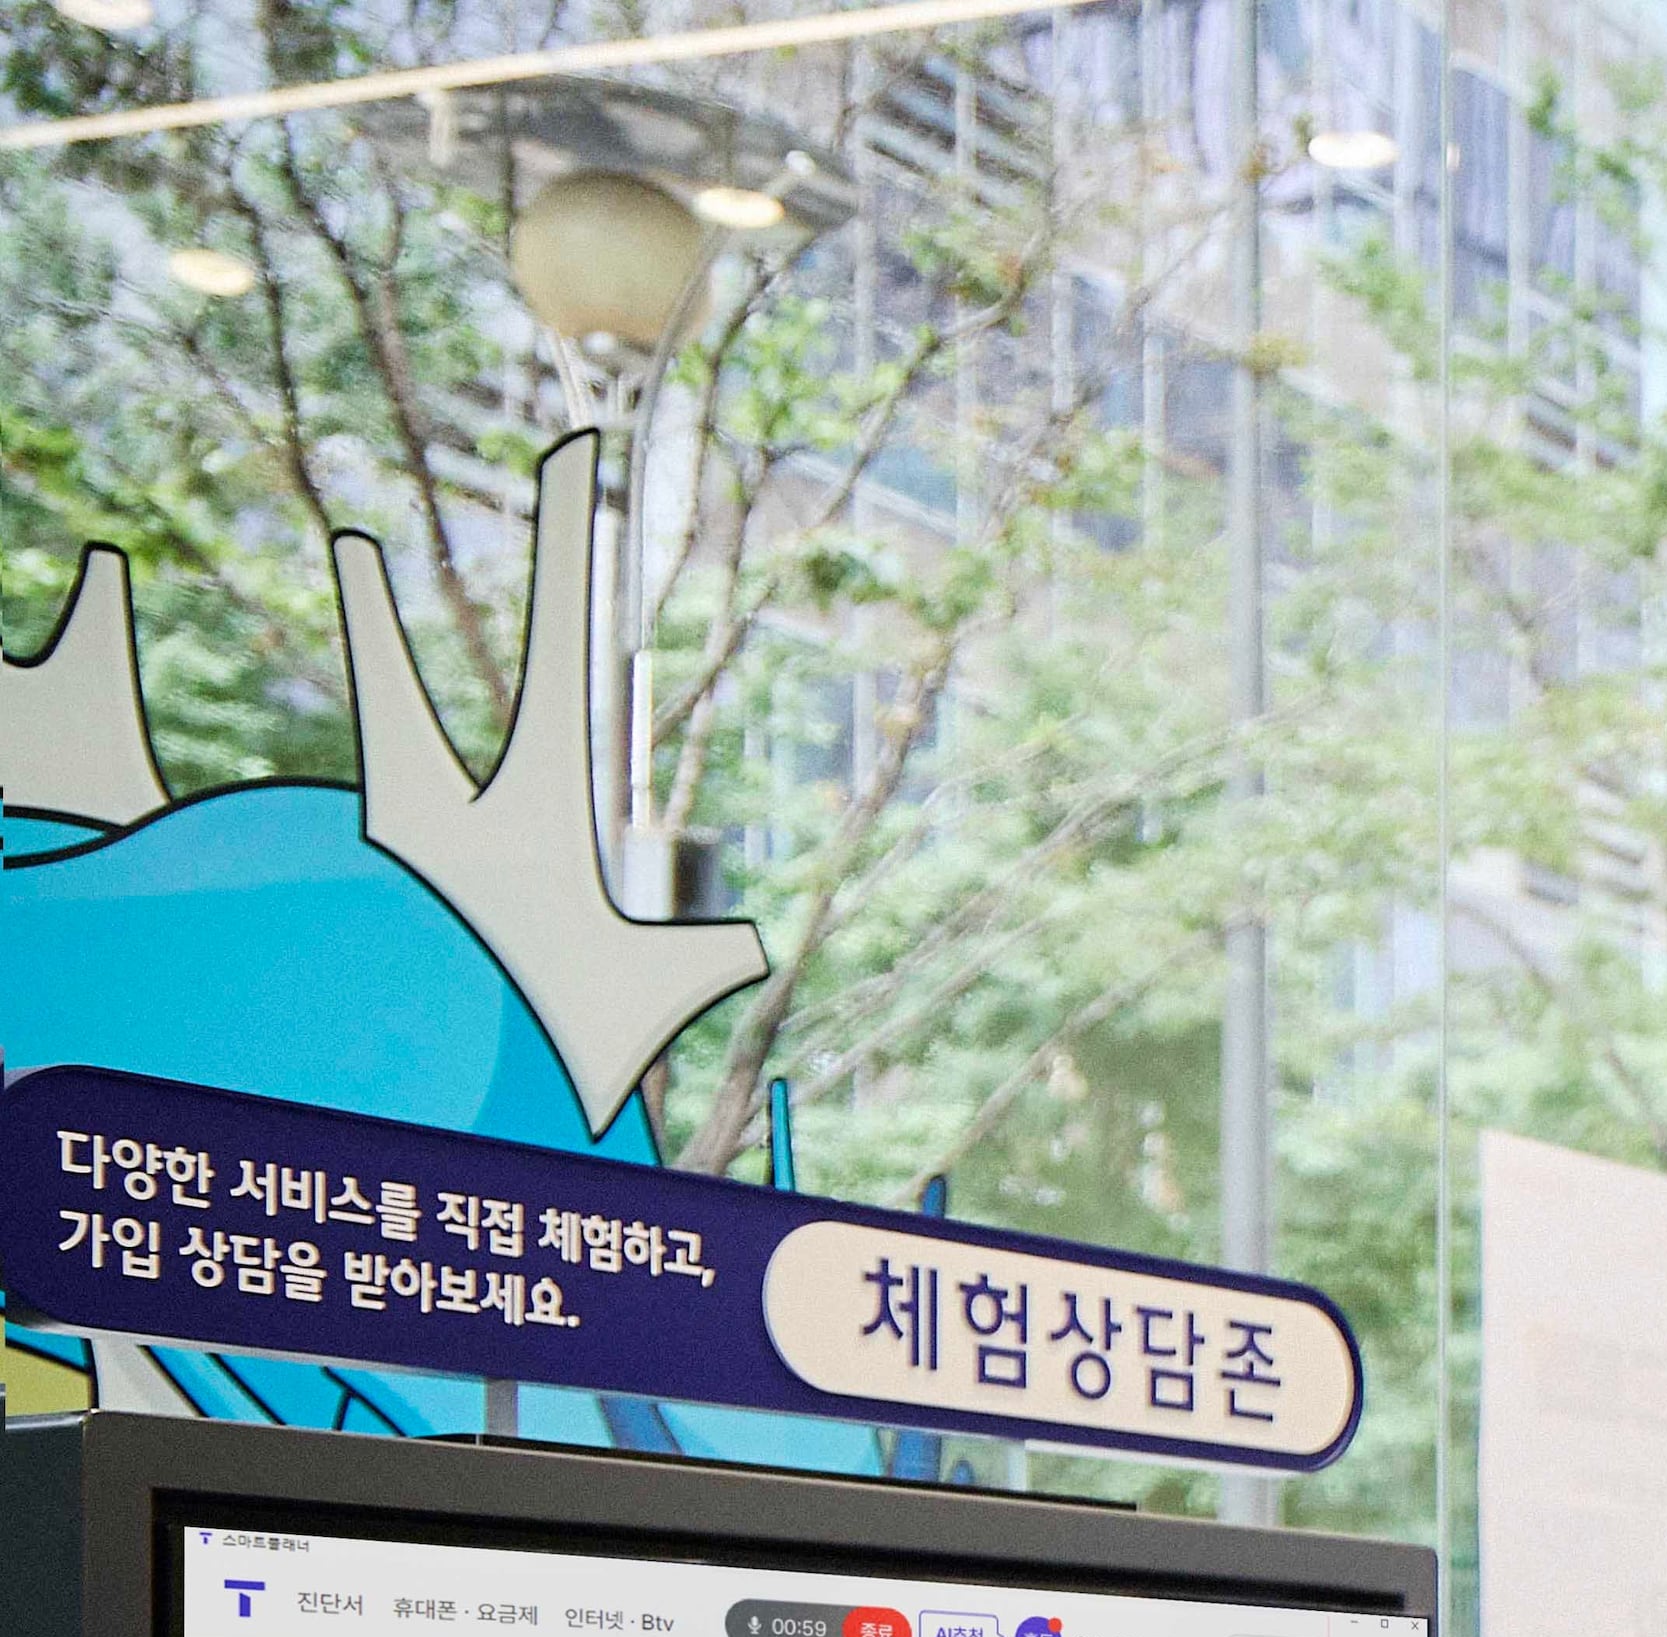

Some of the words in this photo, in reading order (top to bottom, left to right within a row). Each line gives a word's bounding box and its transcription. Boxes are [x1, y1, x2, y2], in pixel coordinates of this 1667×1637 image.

[56, 1129, 216, 1210] 다양한
[230, 1158, 422, 1244] 서비스를
[435, 1189, 524, 1258] 직접
[537, 1205, 716, 1289] 체험하고,
[57, 1209, 162, 1280] 가입
[179, 1226, 328, 1303] 상담을
[344, 1250, 582, 1328] 받아보세요.
[862, 1257, 1283, 1424] 체험상담존
[296, 1591, 363, 1616] 진단서
[393, 1597, 458, 1622] 휴대폰
[476, 1602, 539, 1627] 요금제
[564, 1607, 624, 1631] 인터넷
[641, 1613, 675, 1633] Btv
[771, 1617, 828, 1637] 00:59
